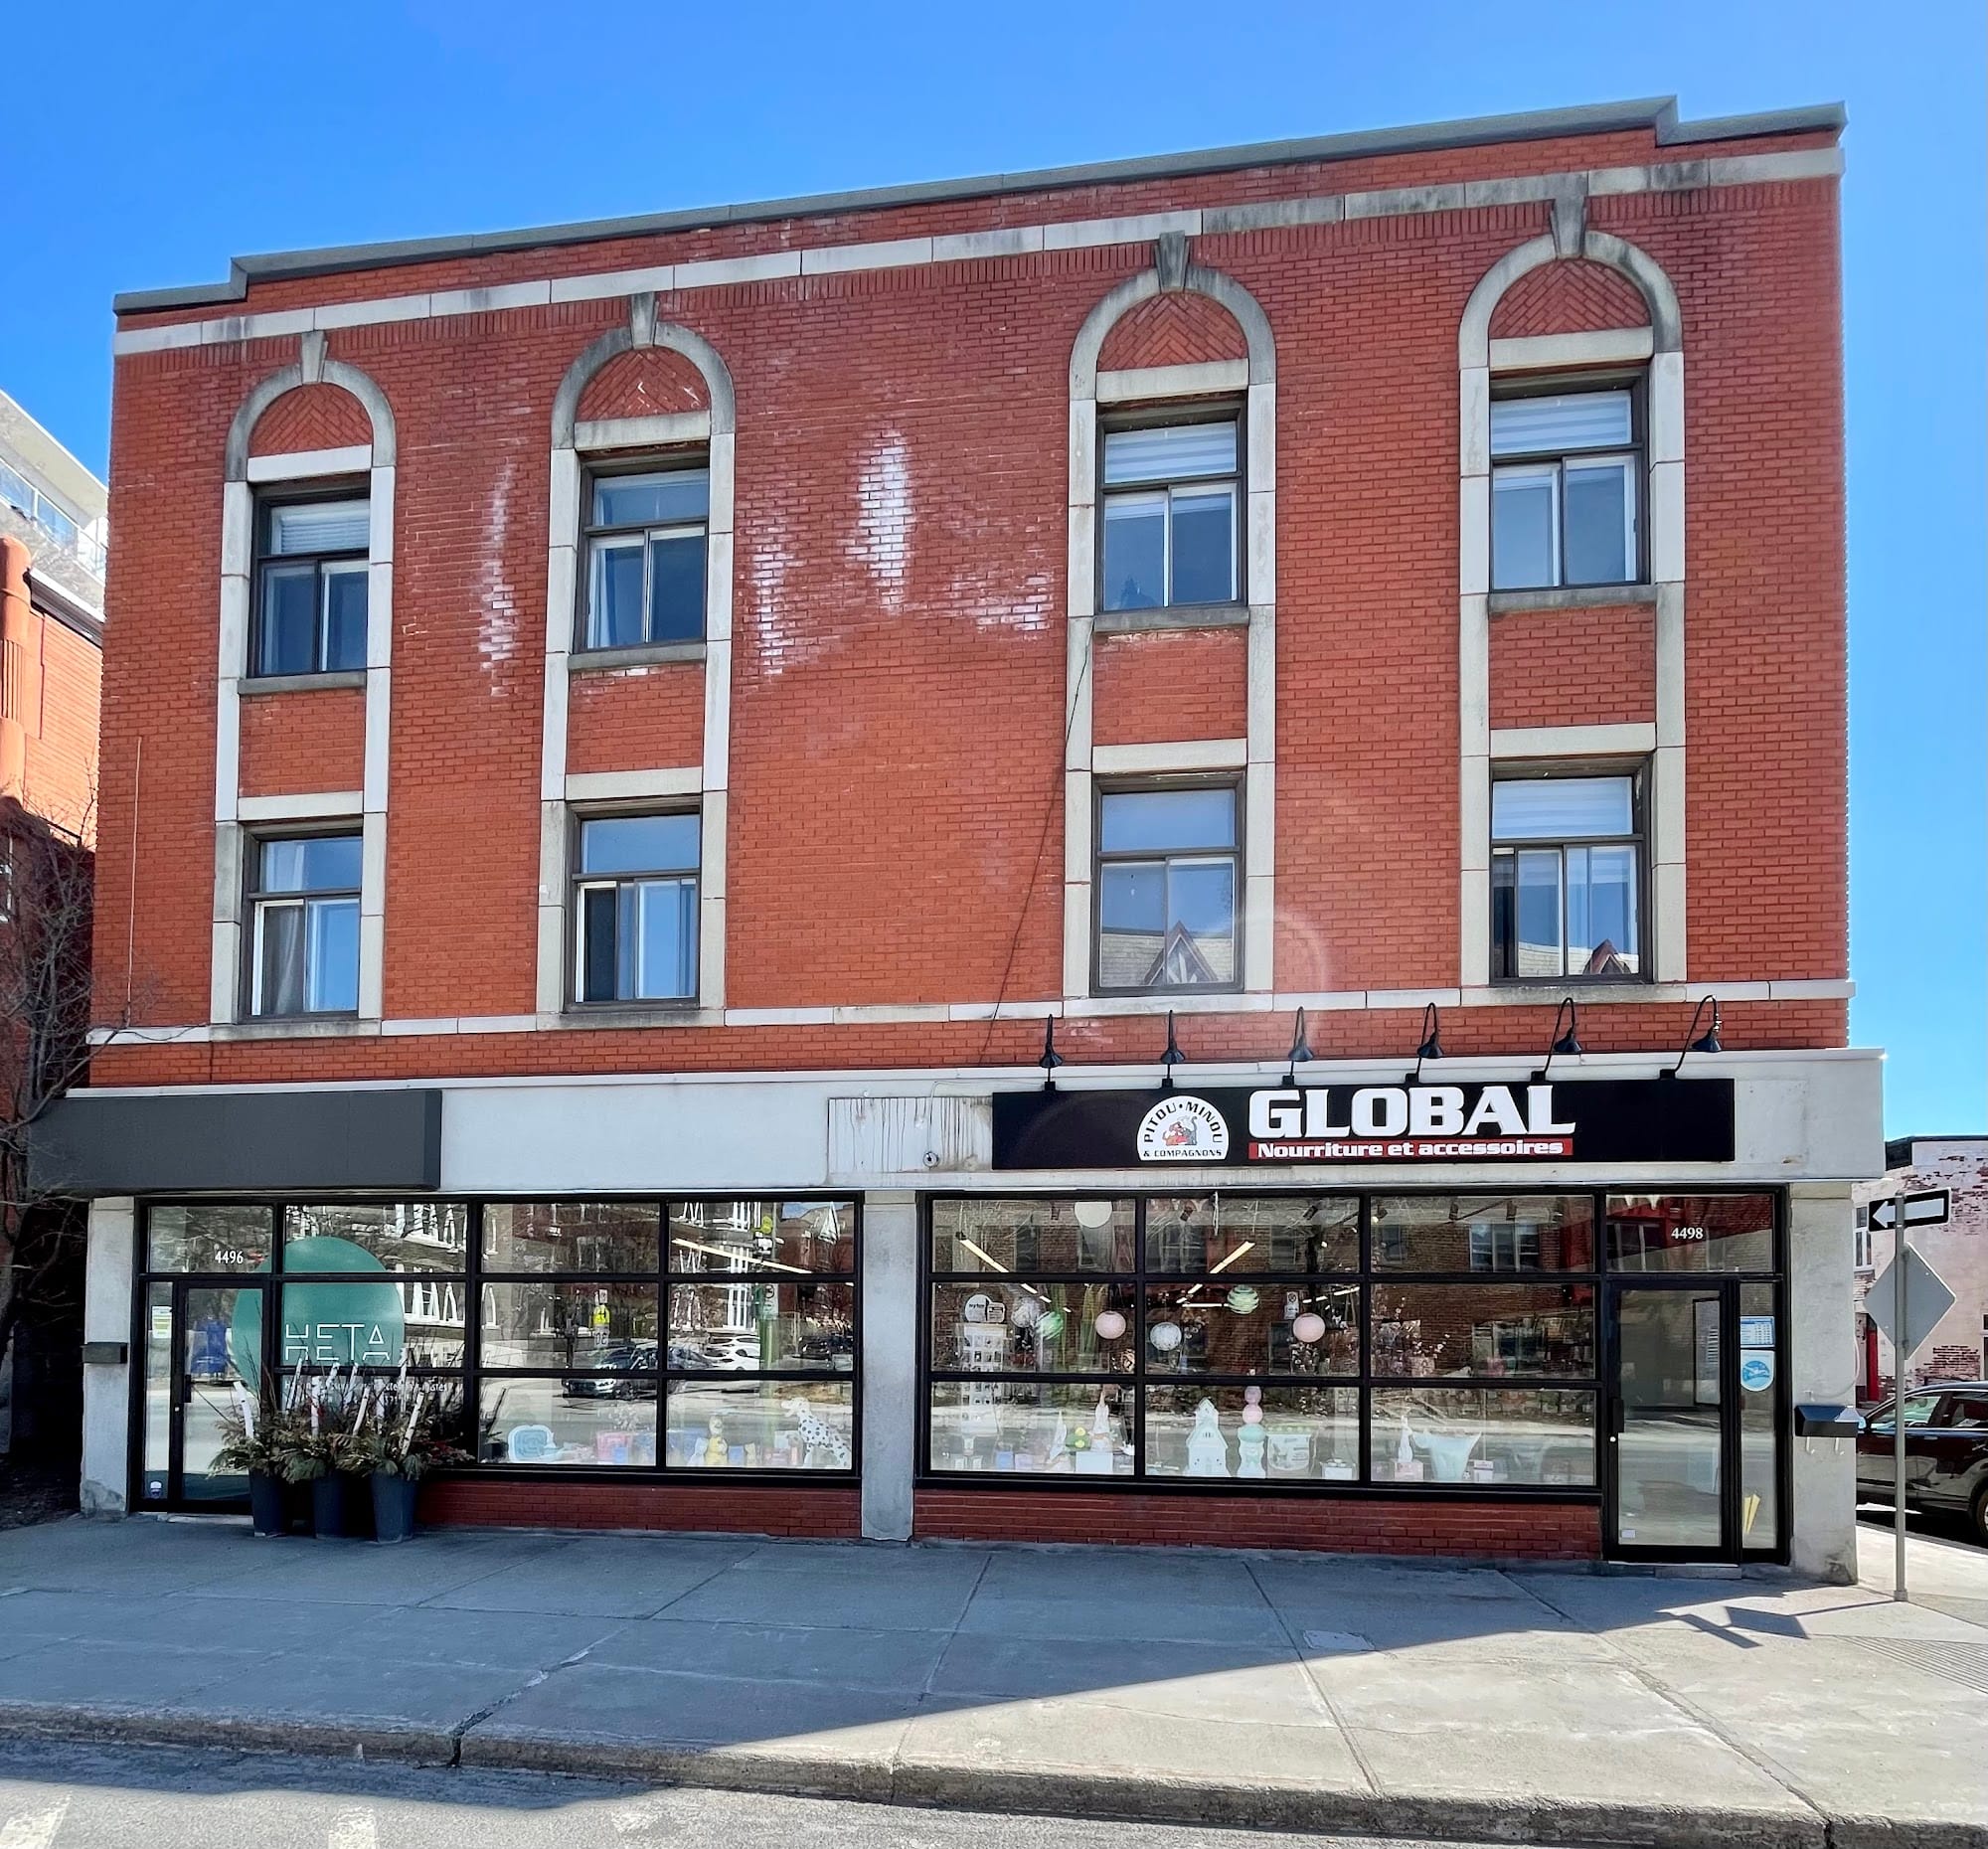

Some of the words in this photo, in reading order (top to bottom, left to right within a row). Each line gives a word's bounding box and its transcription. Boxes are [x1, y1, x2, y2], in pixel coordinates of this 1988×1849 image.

[1144, 1102, 1177, 1142] PITOU
[1186, 1101, 1223, 1142] MINOU
[1248, 1086, 1575, 1138] GLOBAL
[1257, 1142, 1383, 1158] Nourriture
[1388, 1142, 1414, 1157] et
[1418, 1139, 1564, 1156] accessoires
[1671, 1227, 1704, 1240] 4498
[215, 1250, 244, 1263] 4496
[285, 1324, 390, 1361] HETA
